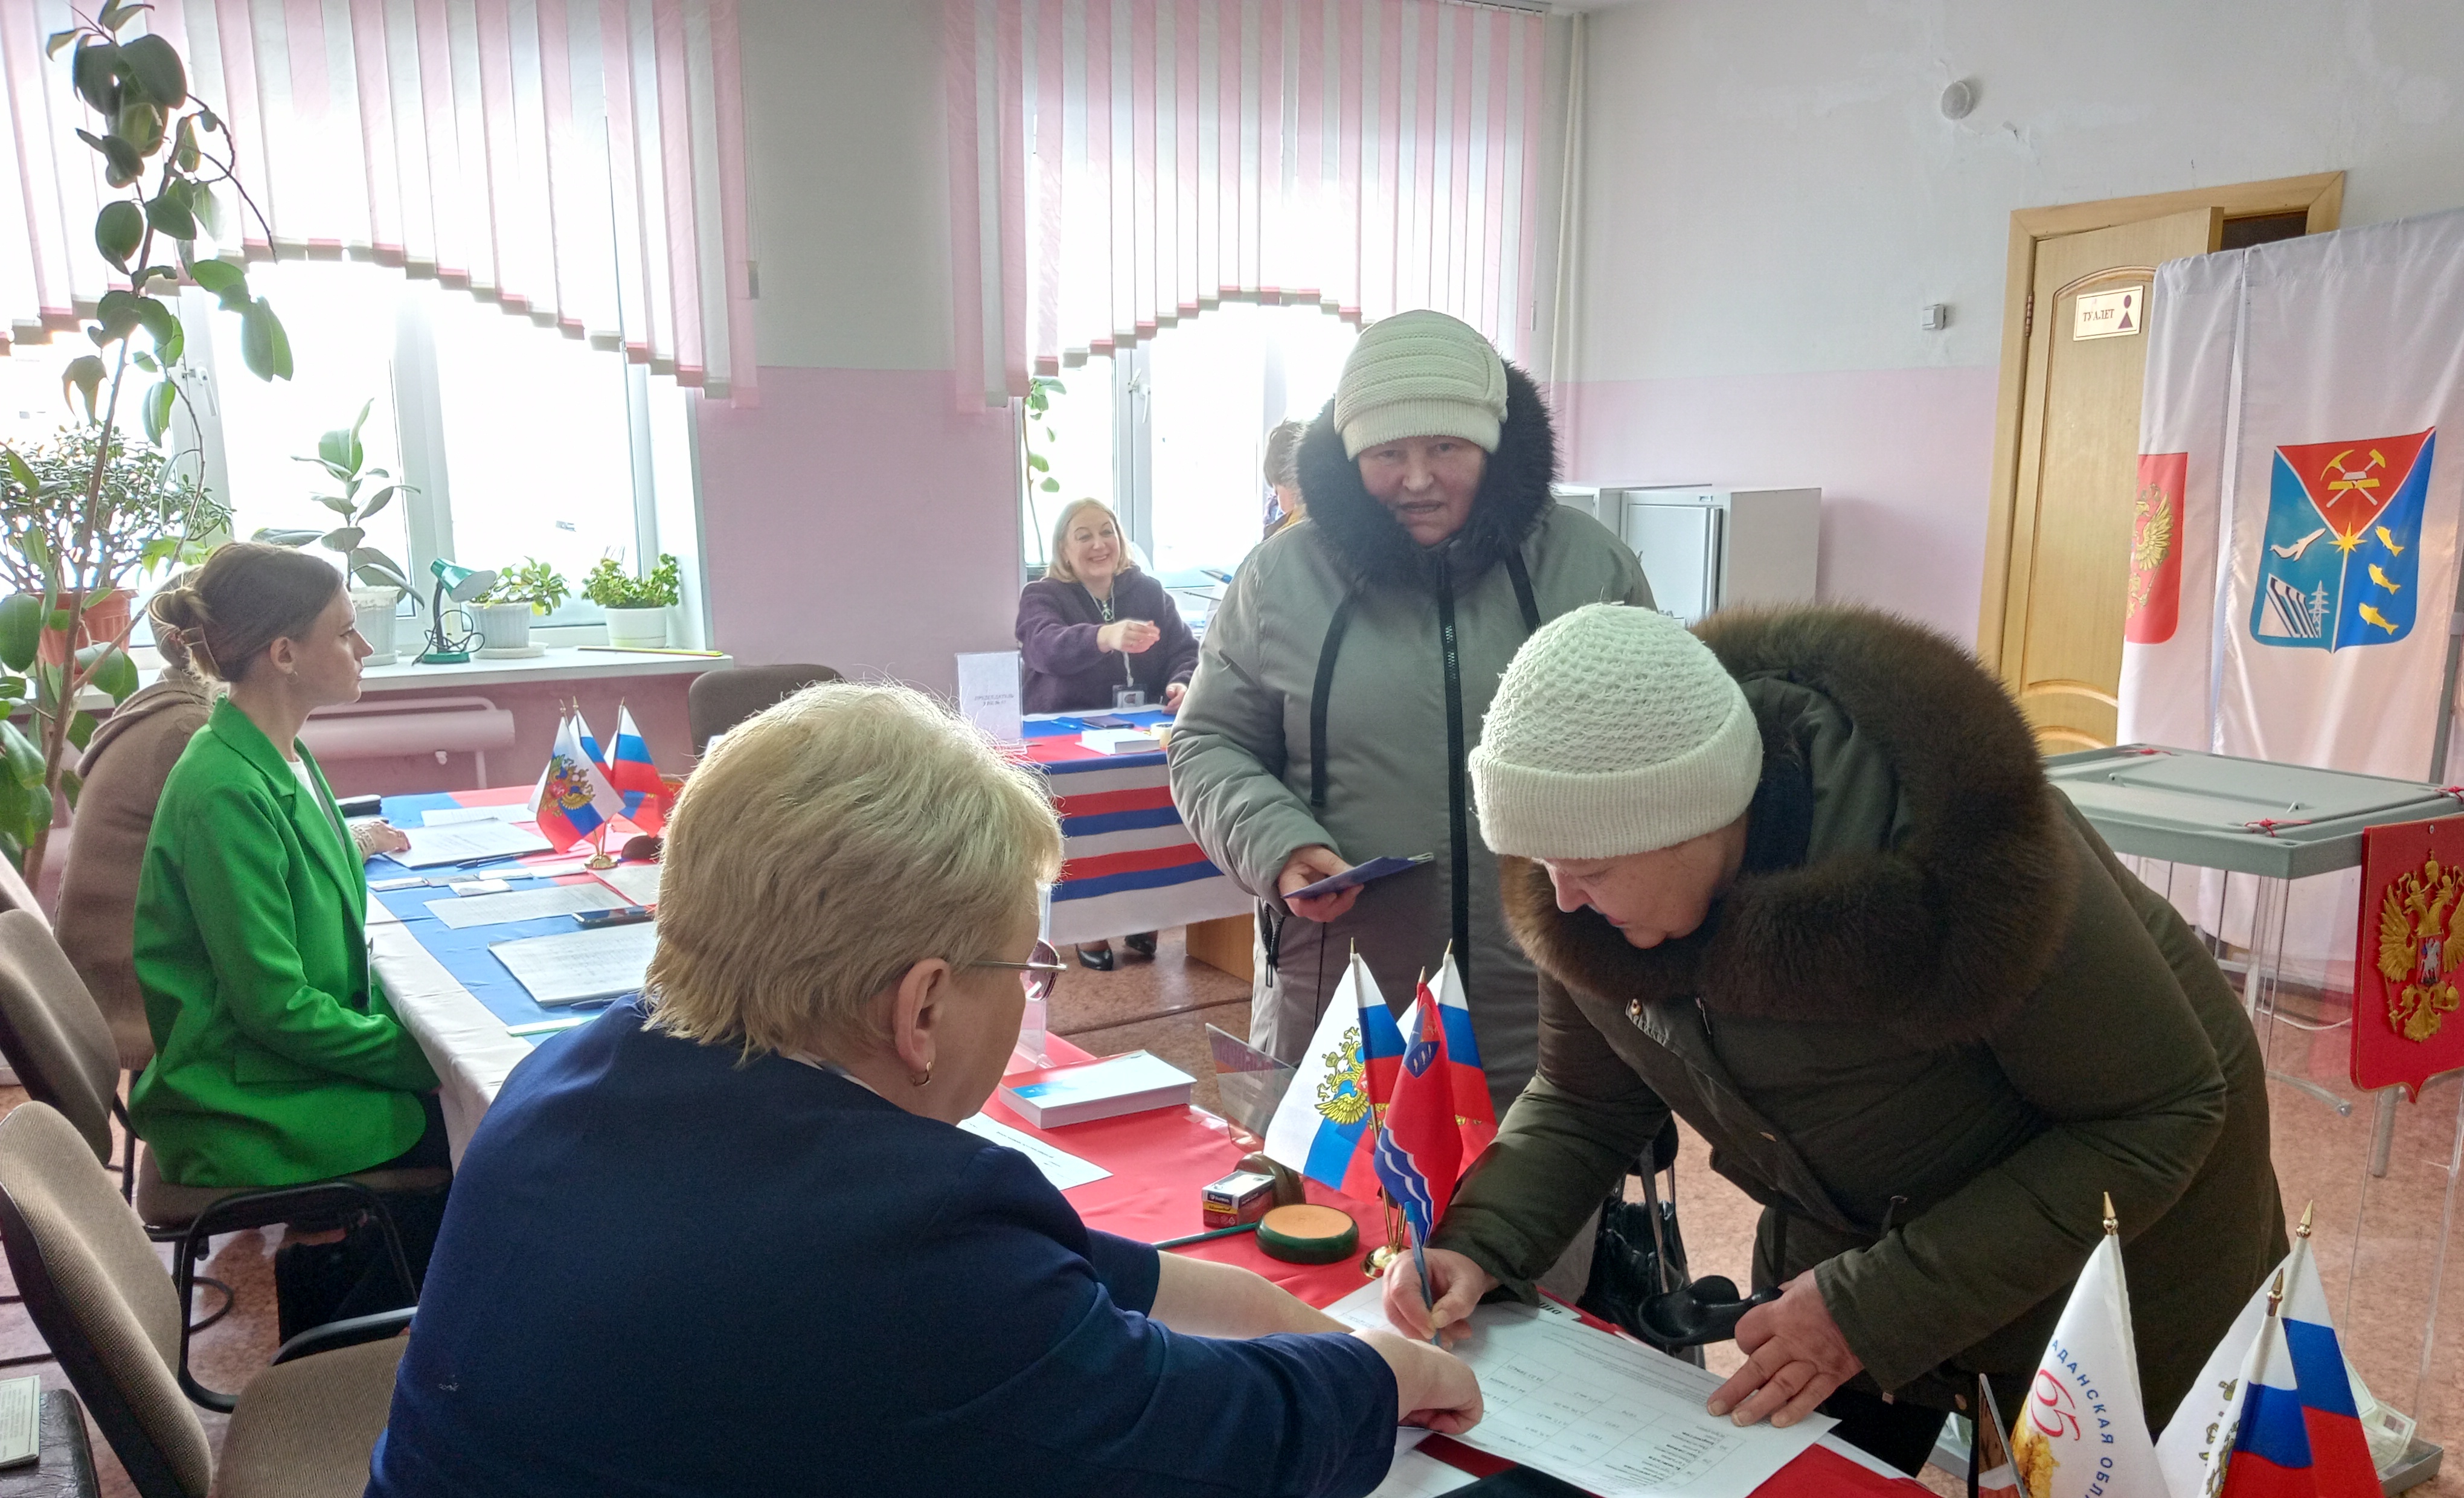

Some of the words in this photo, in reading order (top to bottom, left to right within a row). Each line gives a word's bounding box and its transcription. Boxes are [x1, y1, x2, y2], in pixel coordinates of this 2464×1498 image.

[2083, 309, 2115, 322] ТУАЛЕТ
[2030, 1368, 2081, 1441] 65
[2085, 1456, 2113, 1498] ОБЛ
